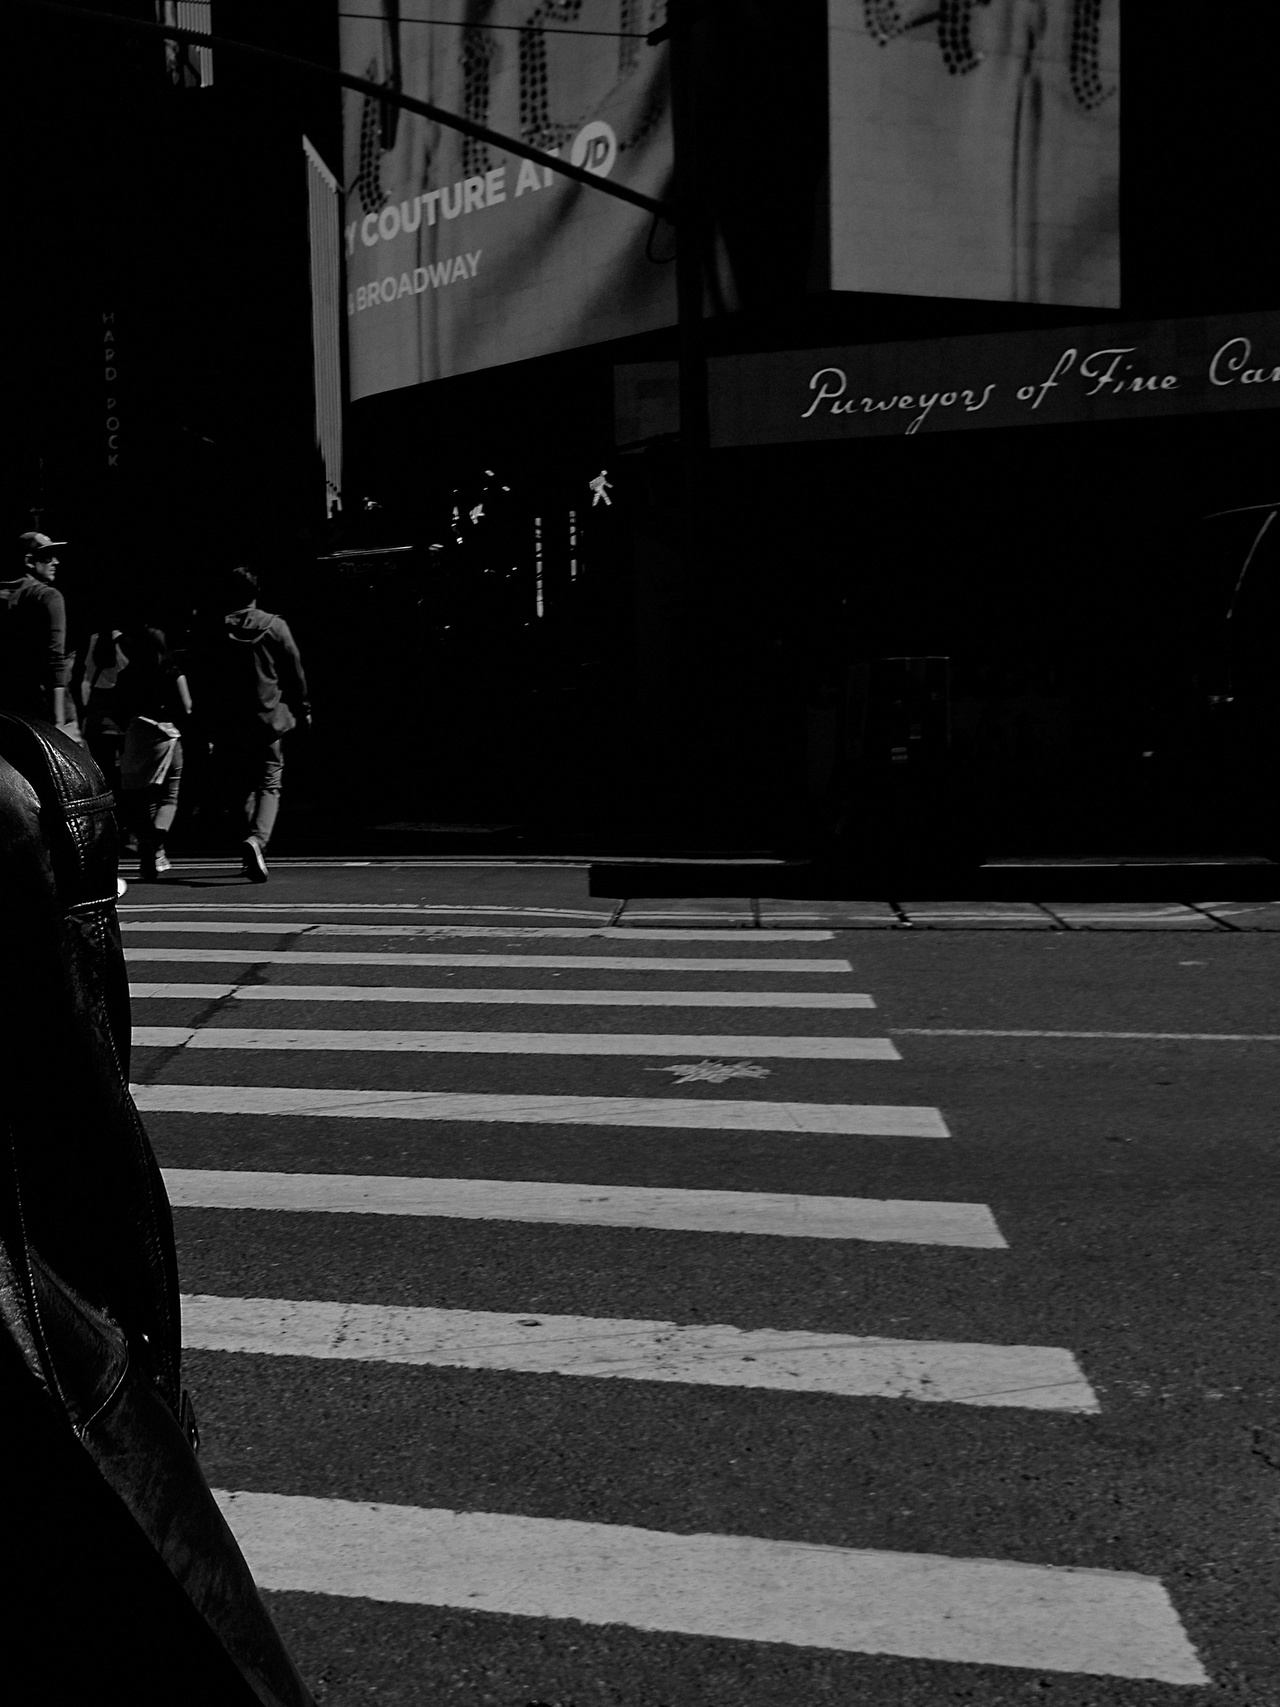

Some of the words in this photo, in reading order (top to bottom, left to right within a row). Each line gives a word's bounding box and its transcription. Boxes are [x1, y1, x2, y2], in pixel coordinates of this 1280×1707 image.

[361, 166, 507, 247] COUTURE
[356, 249, 483, 312] BROADWAY
[801, 367, 998, 435] Purveyors
[1016, 348, 1079, 409] of
[1079, 346, 1181, 397] Fine
